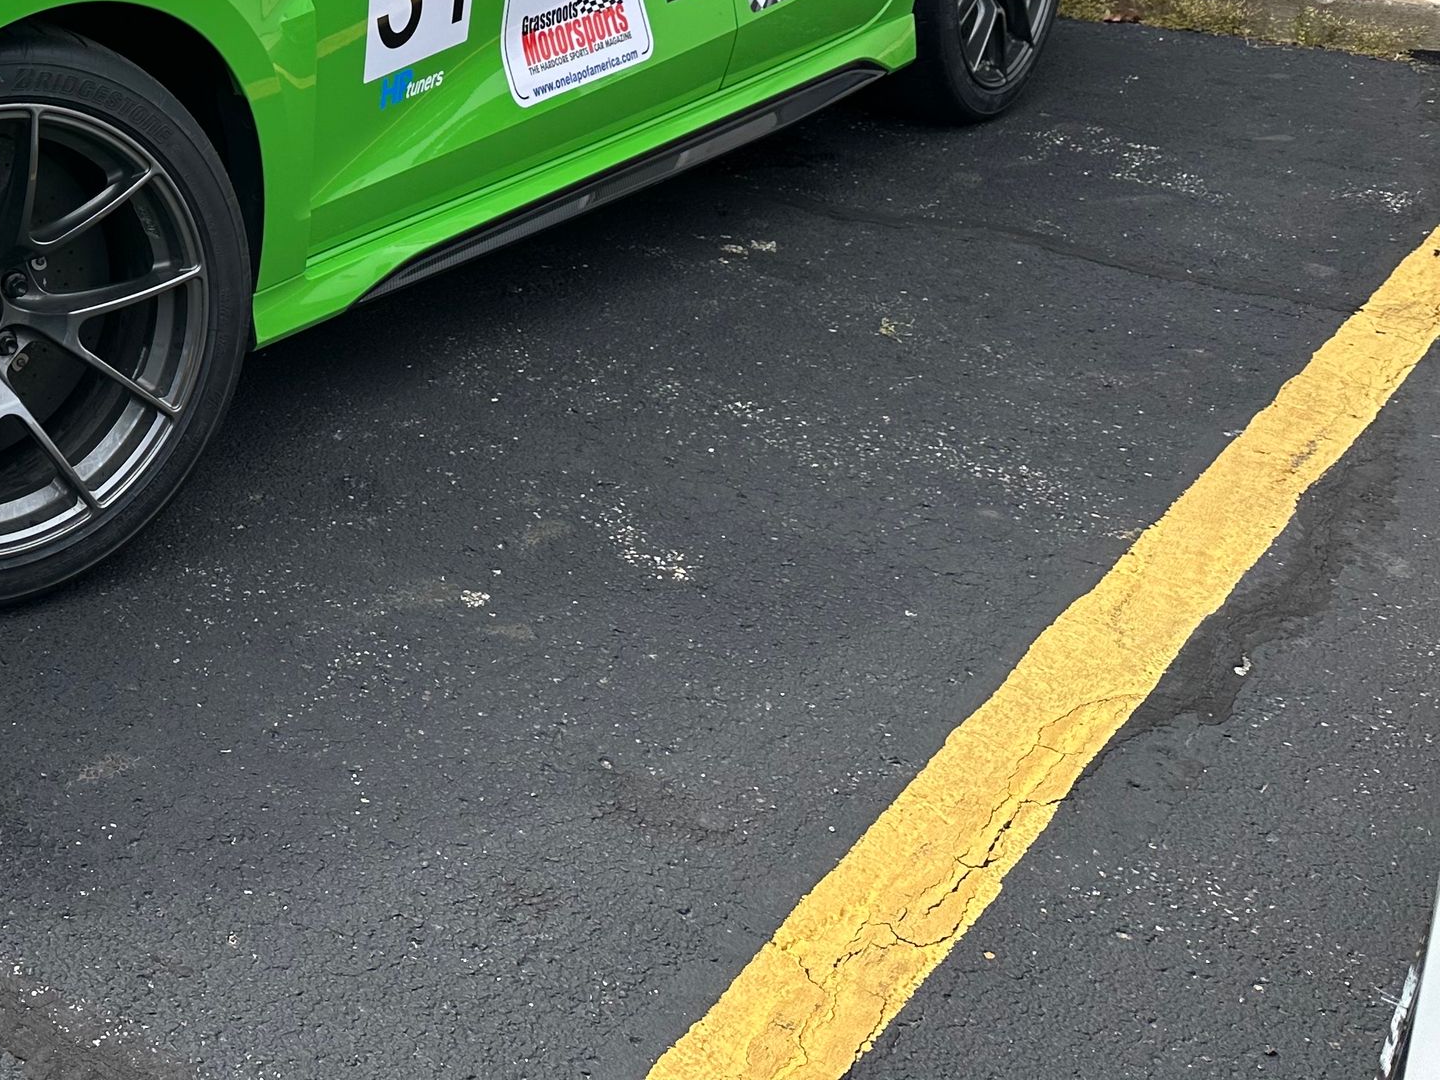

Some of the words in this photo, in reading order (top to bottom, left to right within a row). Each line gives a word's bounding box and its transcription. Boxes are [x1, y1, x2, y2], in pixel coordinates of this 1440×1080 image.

[522, 1, 578, 36] Grassroots
[522, 2, 629, 67] Motorsports
[528, 66, 540, 76] THE
[540, 56, 569, 72] HARDCORE
[569, 47, 589, 61] SPORTS
[594, 41, 604, 52] CAR
[605, 31, 632, 48] MAGAZINE
[533, 49, 638, 97] www.onelapofamerica.com
[10, 67, 175, 145] BRIDGESTONE
